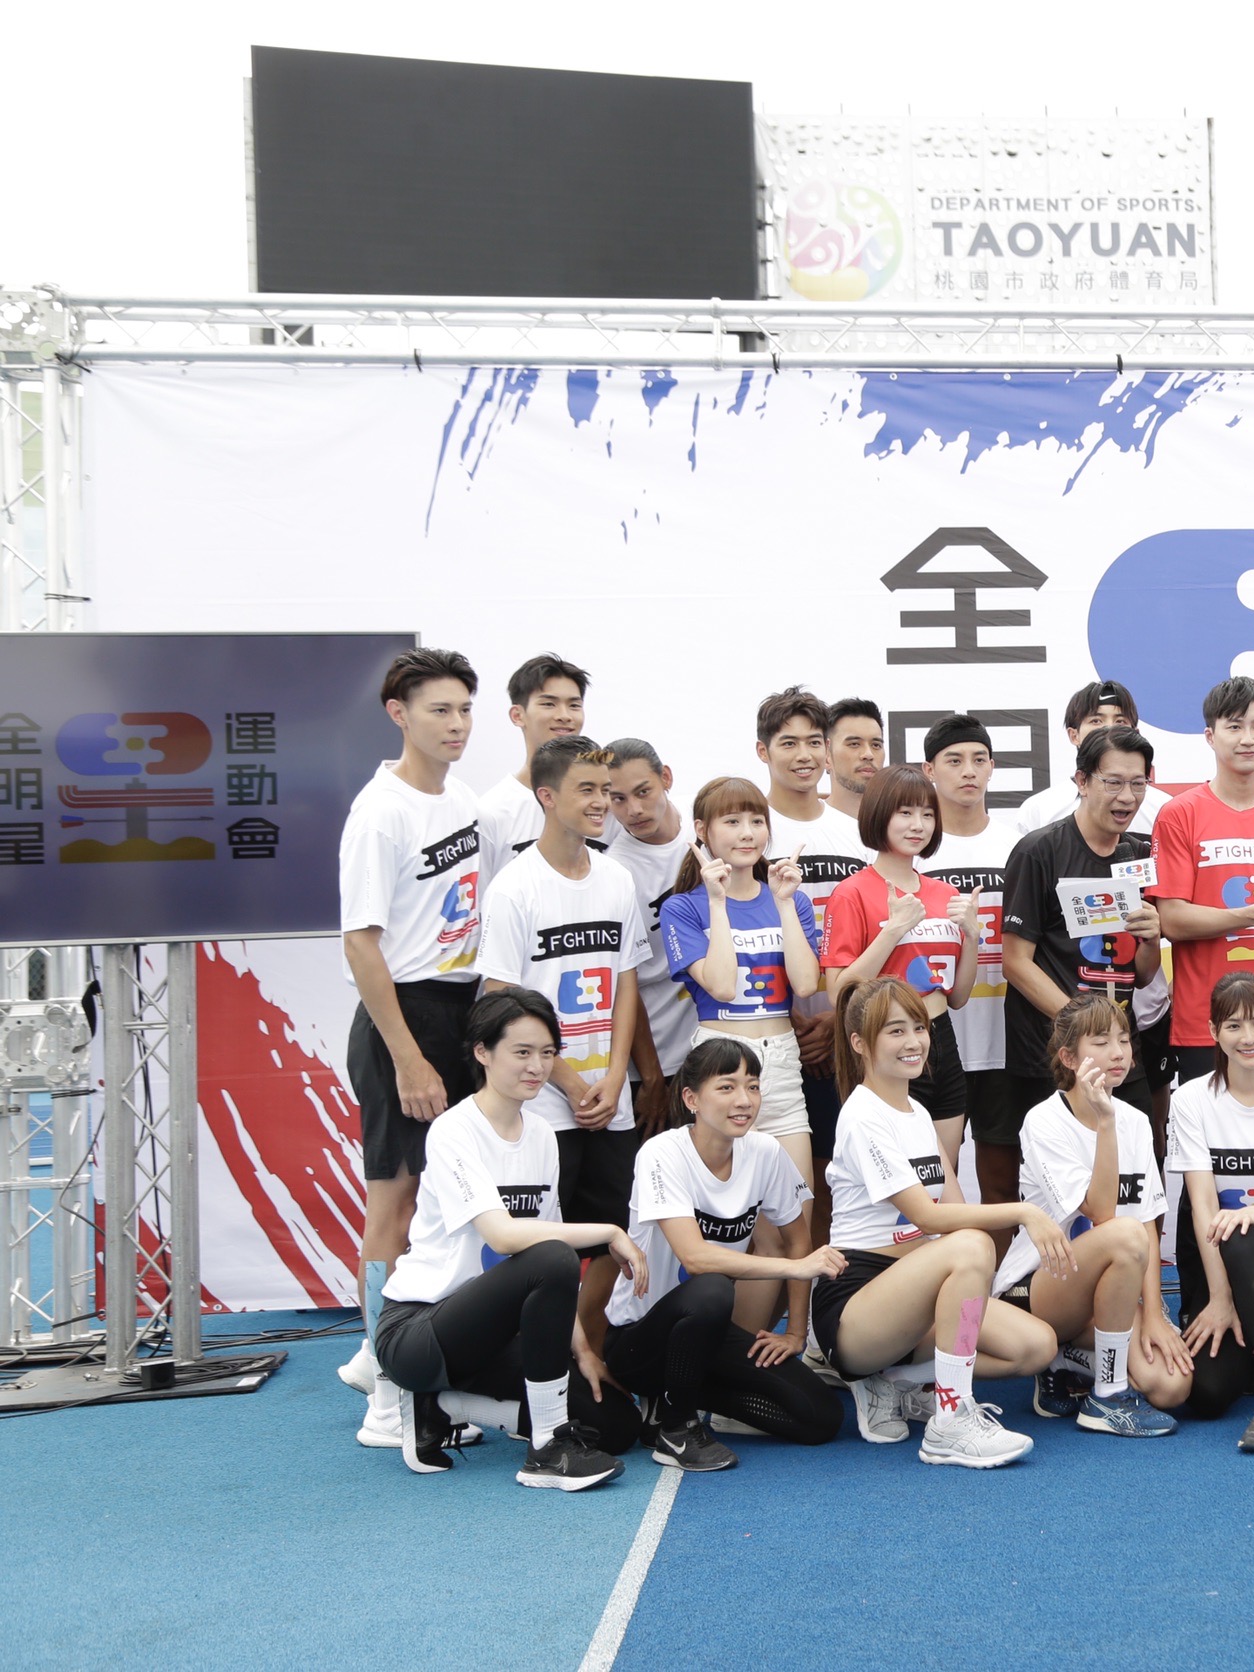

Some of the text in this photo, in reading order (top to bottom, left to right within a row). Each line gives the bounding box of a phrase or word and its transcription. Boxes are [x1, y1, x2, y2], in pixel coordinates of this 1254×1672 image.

[931, 196, 1195, 213] DEPARTMENT OF SPORTS
[931, 221, 1197, 259] TAOYUAN
[934, 270, 1198, 292] 桃園市政府體育局
[224, 712, 281, 860] 運動會
[796, 861, 859, 876] GHTING
[931, 873, 1005, 888] IGHTIN
[909, 922, 960, 936] IGHTIN
[550, 929, 619, 951] FGHTING
[733, 931, 784, 948] GHTIN
[917, 1162, 944, 1180] GHTIN
[501, 1194, 541, 1211] GHTIN
[699, 1214, 755, 1237] HTING
